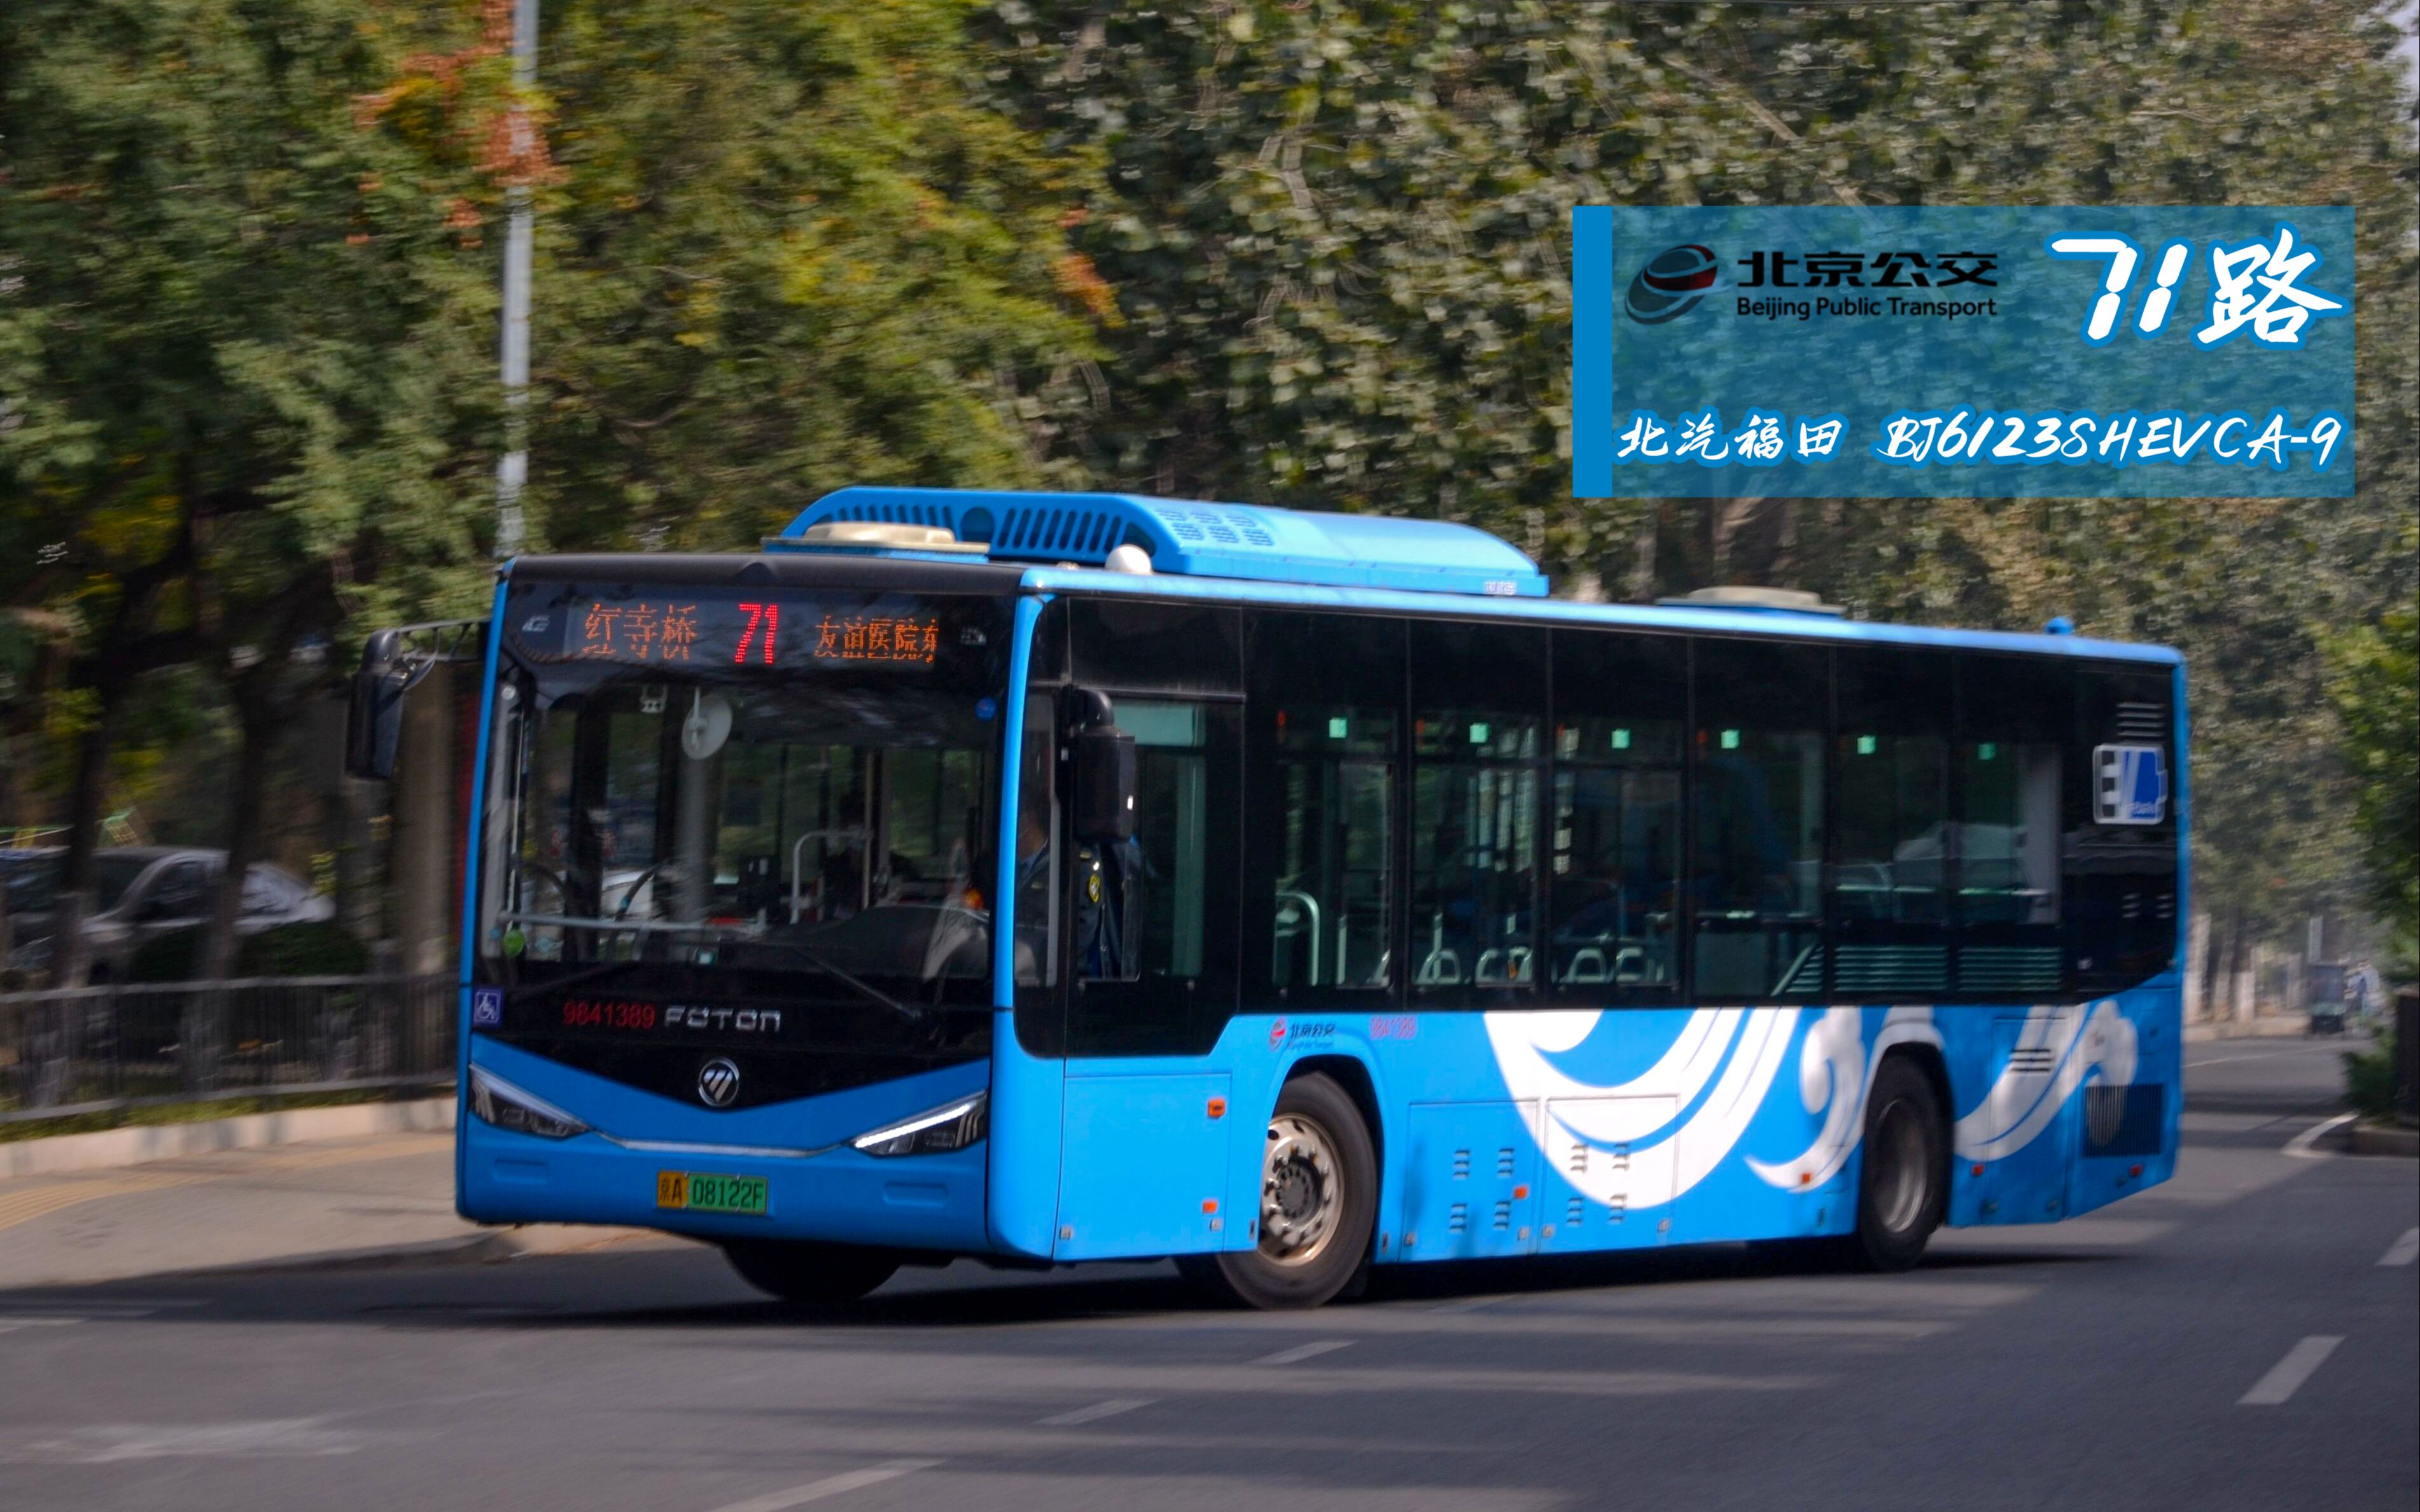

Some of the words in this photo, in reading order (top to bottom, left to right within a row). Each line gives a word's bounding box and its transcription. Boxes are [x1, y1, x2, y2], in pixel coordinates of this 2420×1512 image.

[734, 602, 779, 665] 71
[563, 1001, 656, 1029] 9841389
[664, 1005, 781, 1032] FOTON
